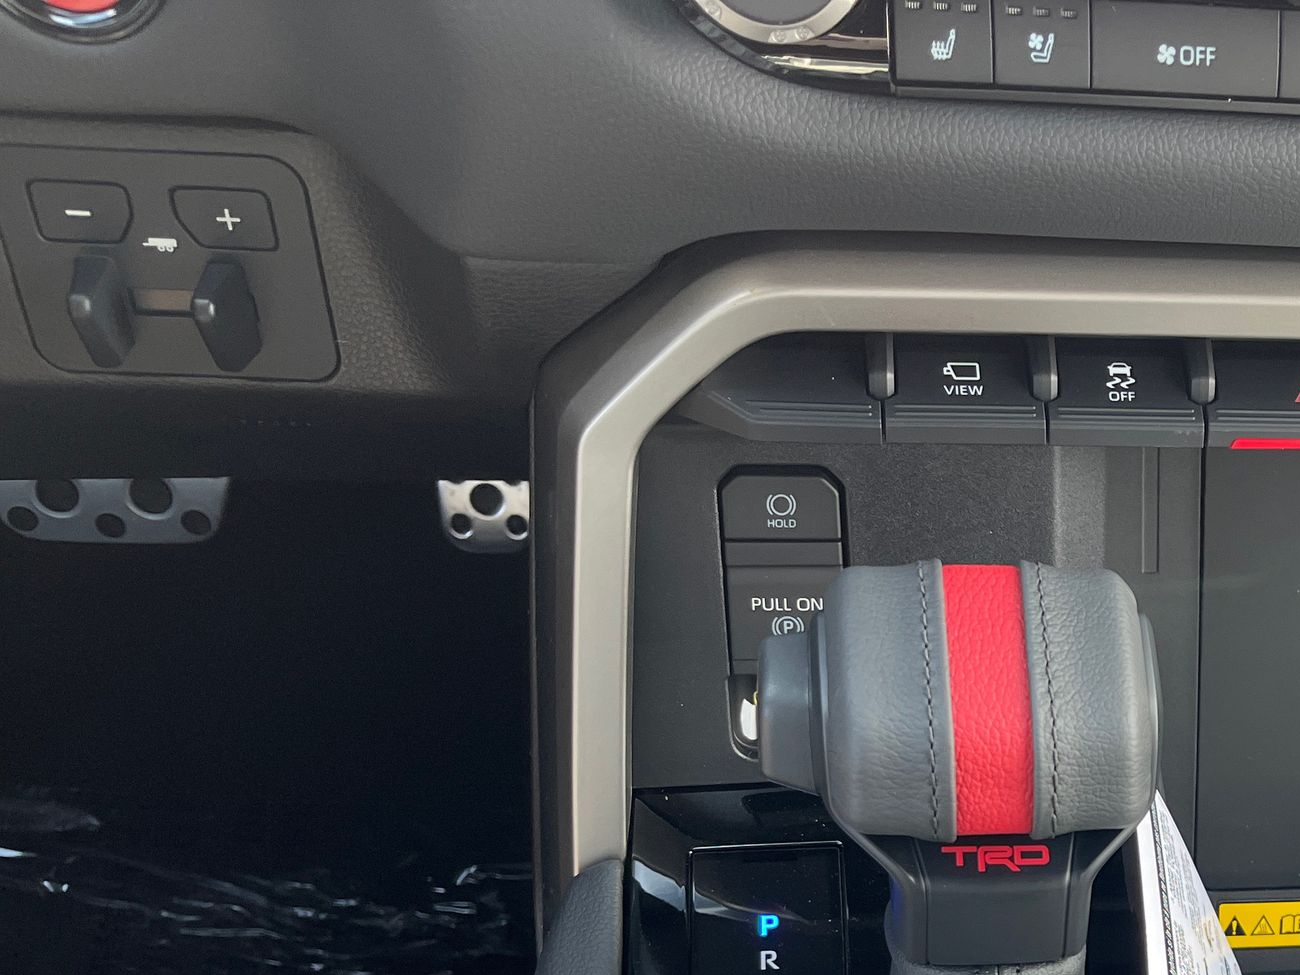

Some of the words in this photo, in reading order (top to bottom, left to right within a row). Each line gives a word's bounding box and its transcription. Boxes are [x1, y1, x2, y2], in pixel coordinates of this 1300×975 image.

[1179, 45, 1216, 67] OFF
[943, 384, 984, 396] VIEW
[1108, 391, 1137, 402] OFF
[767, 518, 797, 529] HOLD
[751, 597, 792, 612] PULL
[796, 597, 824, 612] ON
[941, 845, 1050, 872] TRD
[759, 914, 780, 937] P
[760, 950, 780, 971] R
